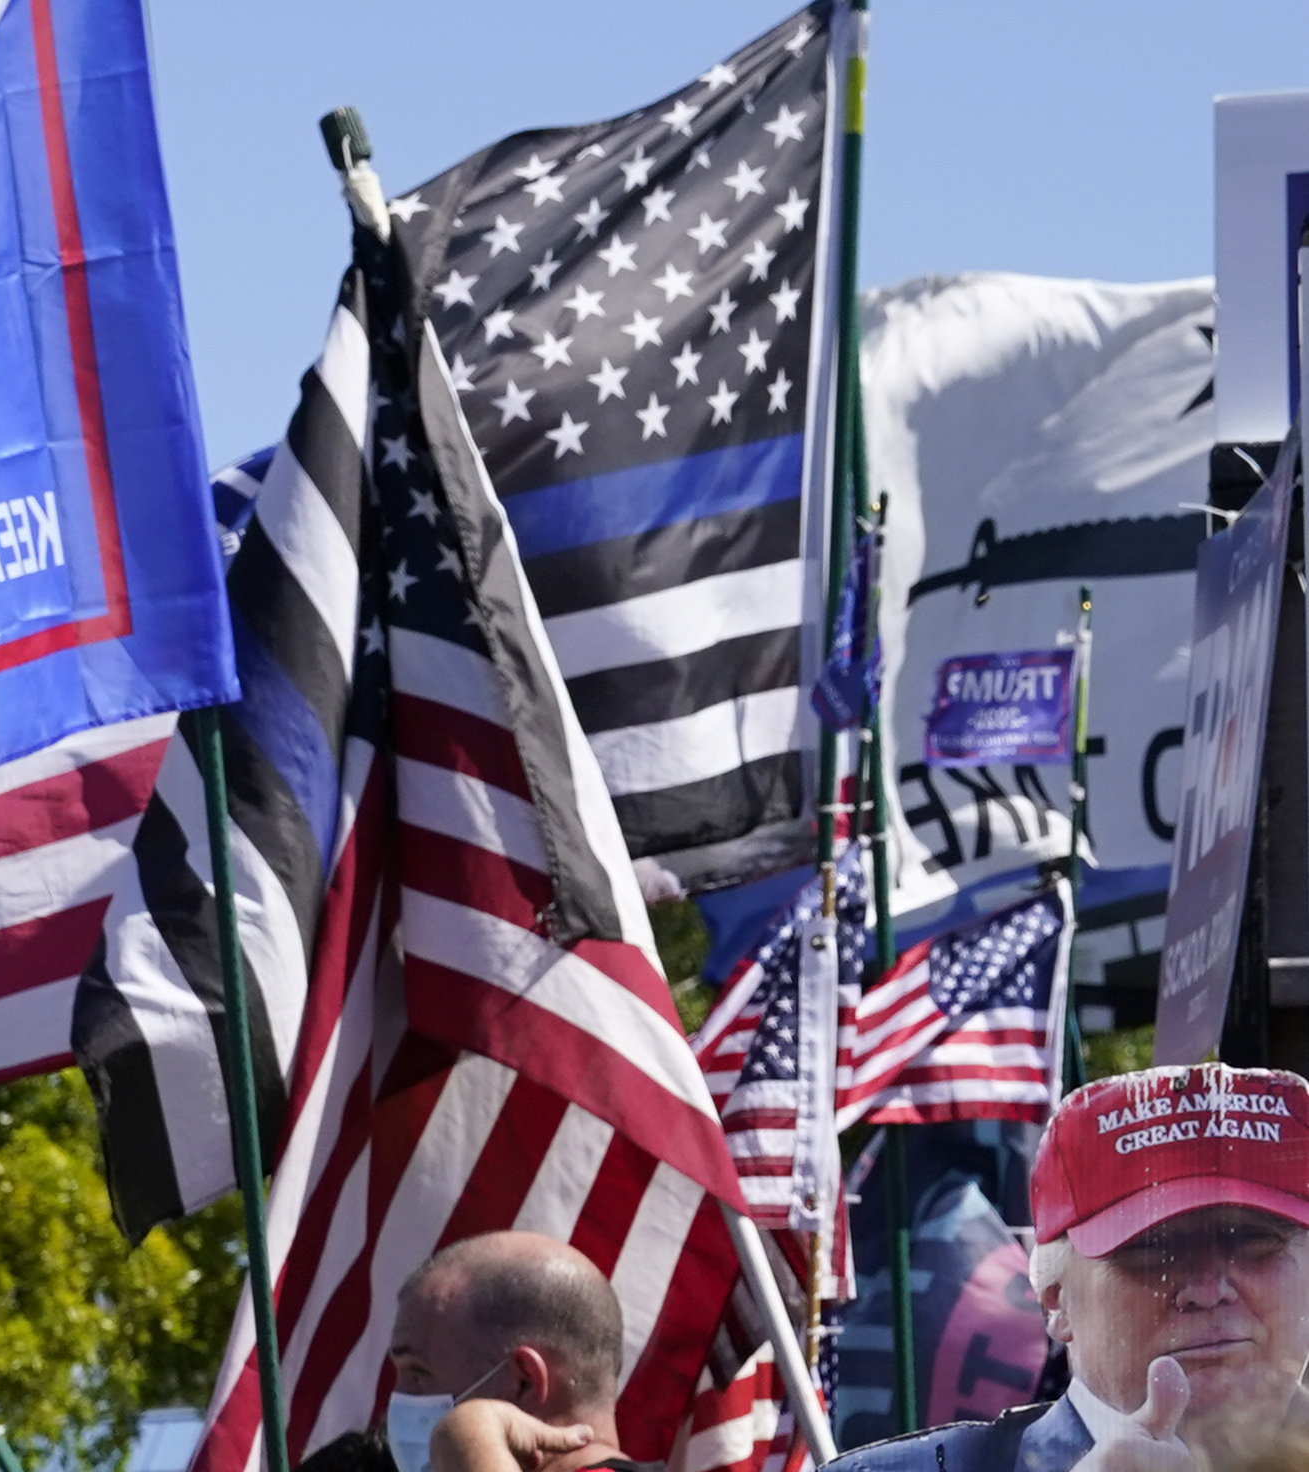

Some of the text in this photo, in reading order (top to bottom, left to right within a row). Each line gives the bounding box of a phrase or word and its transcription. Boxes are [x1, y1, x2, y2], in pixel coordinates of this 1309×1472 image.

[1097, 1093, 1291, 1135] MAKE AMERICA
[1115, 1118, 1281, 1154] GREAT AGAIN
